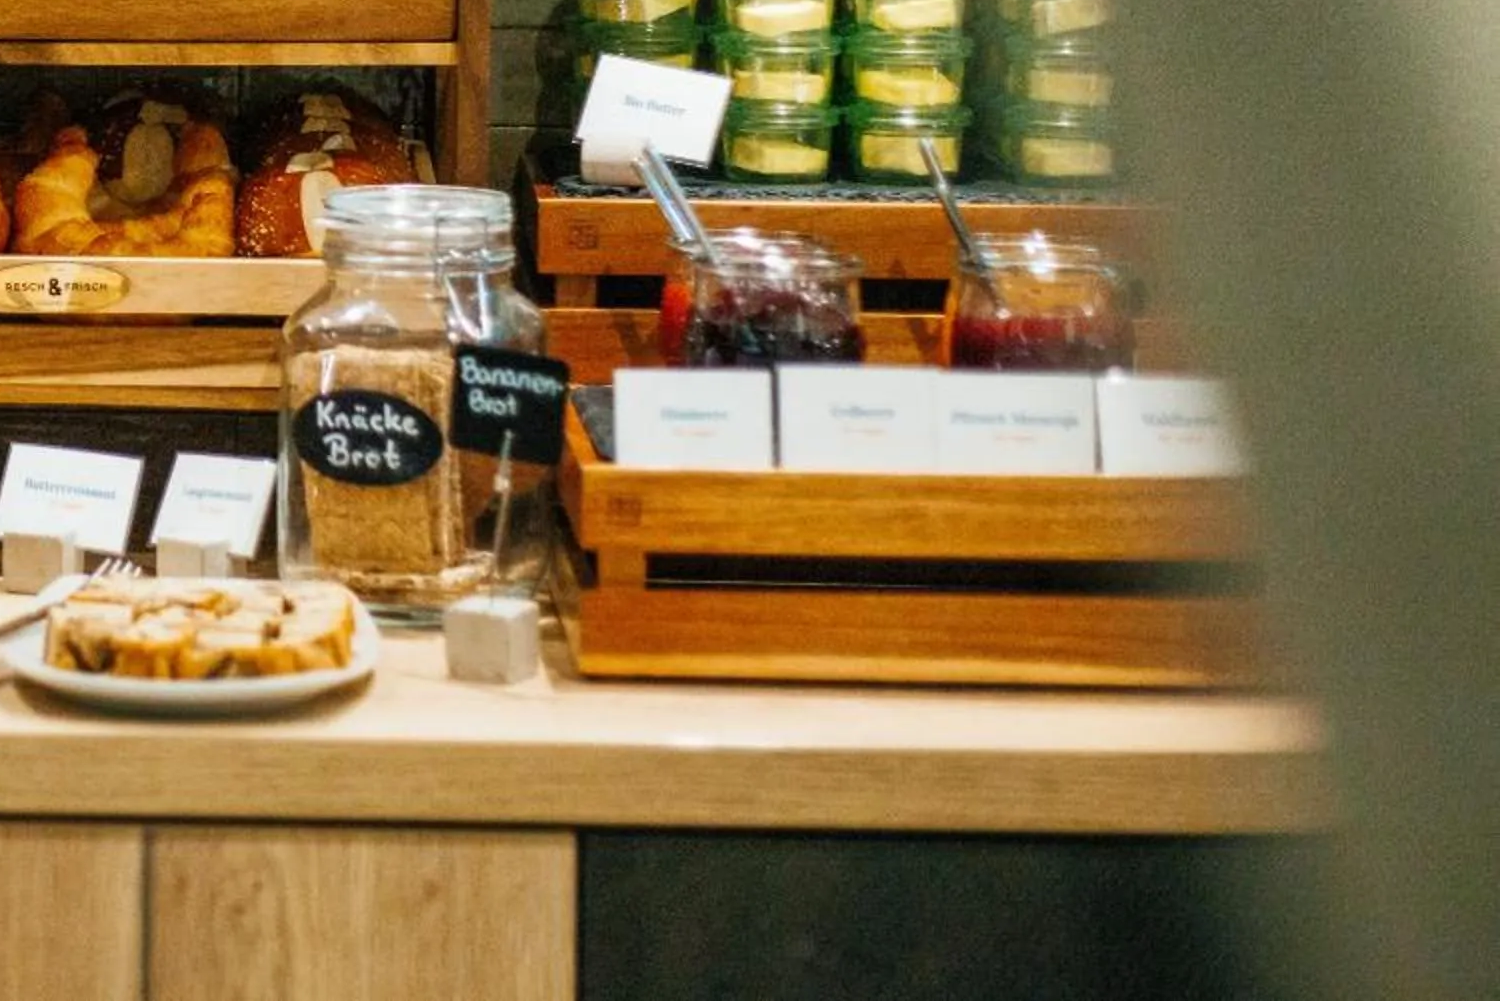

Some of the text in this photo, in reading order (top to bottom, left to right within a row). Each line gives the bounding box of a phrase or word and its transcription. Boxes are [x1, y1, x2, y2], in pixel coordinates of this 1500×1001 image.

[5, 278, 108, 296] RESCH & FRISCH
[469, 388, 518, 416] Brot
[316, 400, 420, 437] Knäcke
[322, 432, 402, 470] Brot
